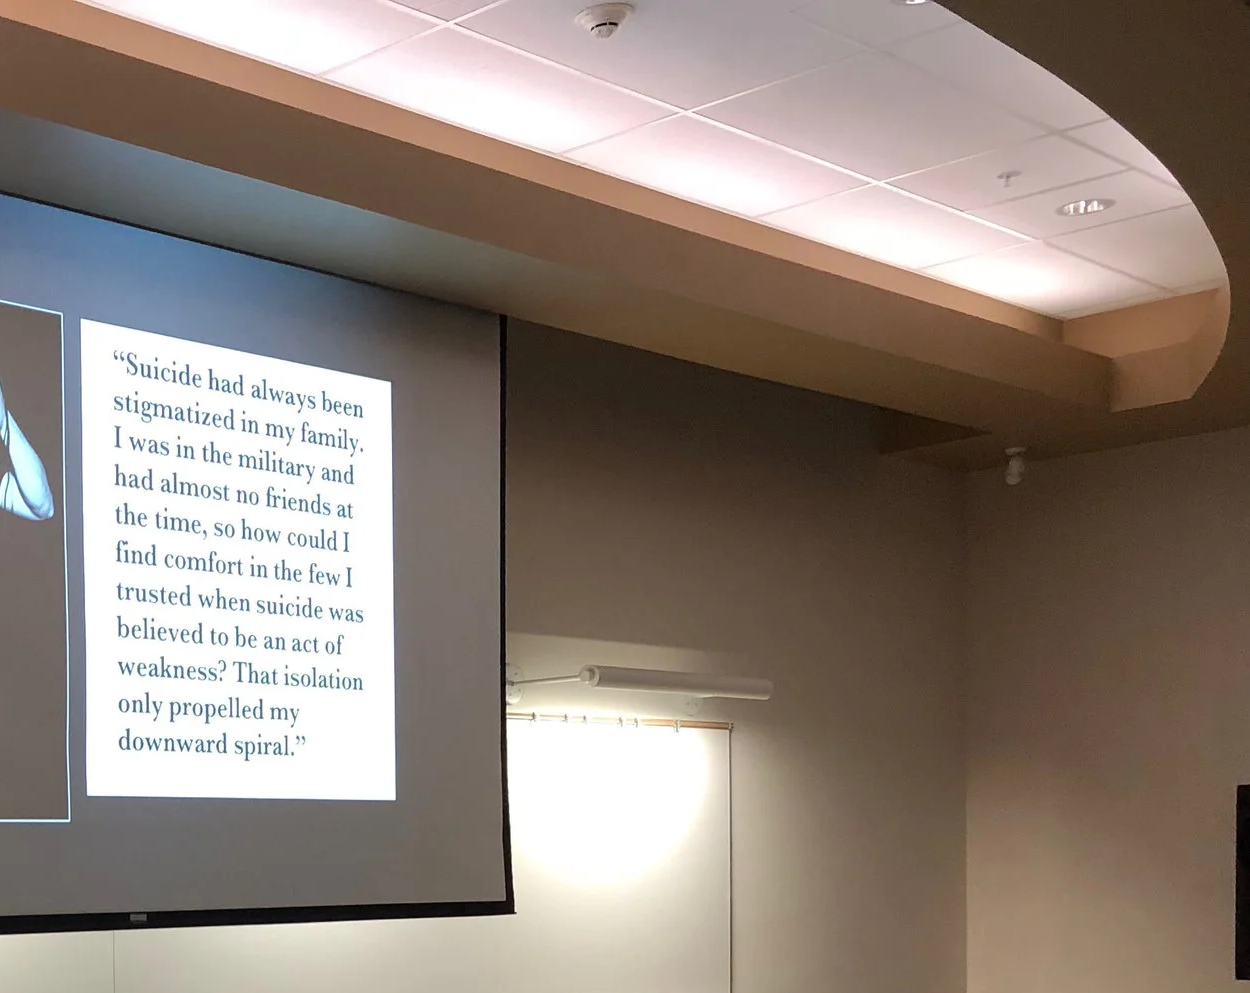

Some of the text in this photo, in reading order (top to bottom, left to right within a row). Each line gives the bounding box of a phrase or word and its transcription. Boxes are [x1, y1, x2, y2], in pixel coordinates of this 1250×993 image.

[114, 350, 363, 418] “Suicide had always been
[114, 391, 363, 457] stigmatized in my family.
[114, 425, 354, 485] I was in the military and
[114, 464, 353, 519] had almost no friends at
[115, 503, 349, 552] the time, so how could I
[116, 540, 352, 588] find comfort in the few I
[116, 583, 363, 623] trusted when suicide was
[117, 615, 344, 655] believed to be an act of
[118, 656, 363, 690] weakness? That isolation
[118, 692, 299, 728] only propelled my
[118, 728, 305, 762] downward spiral.”
